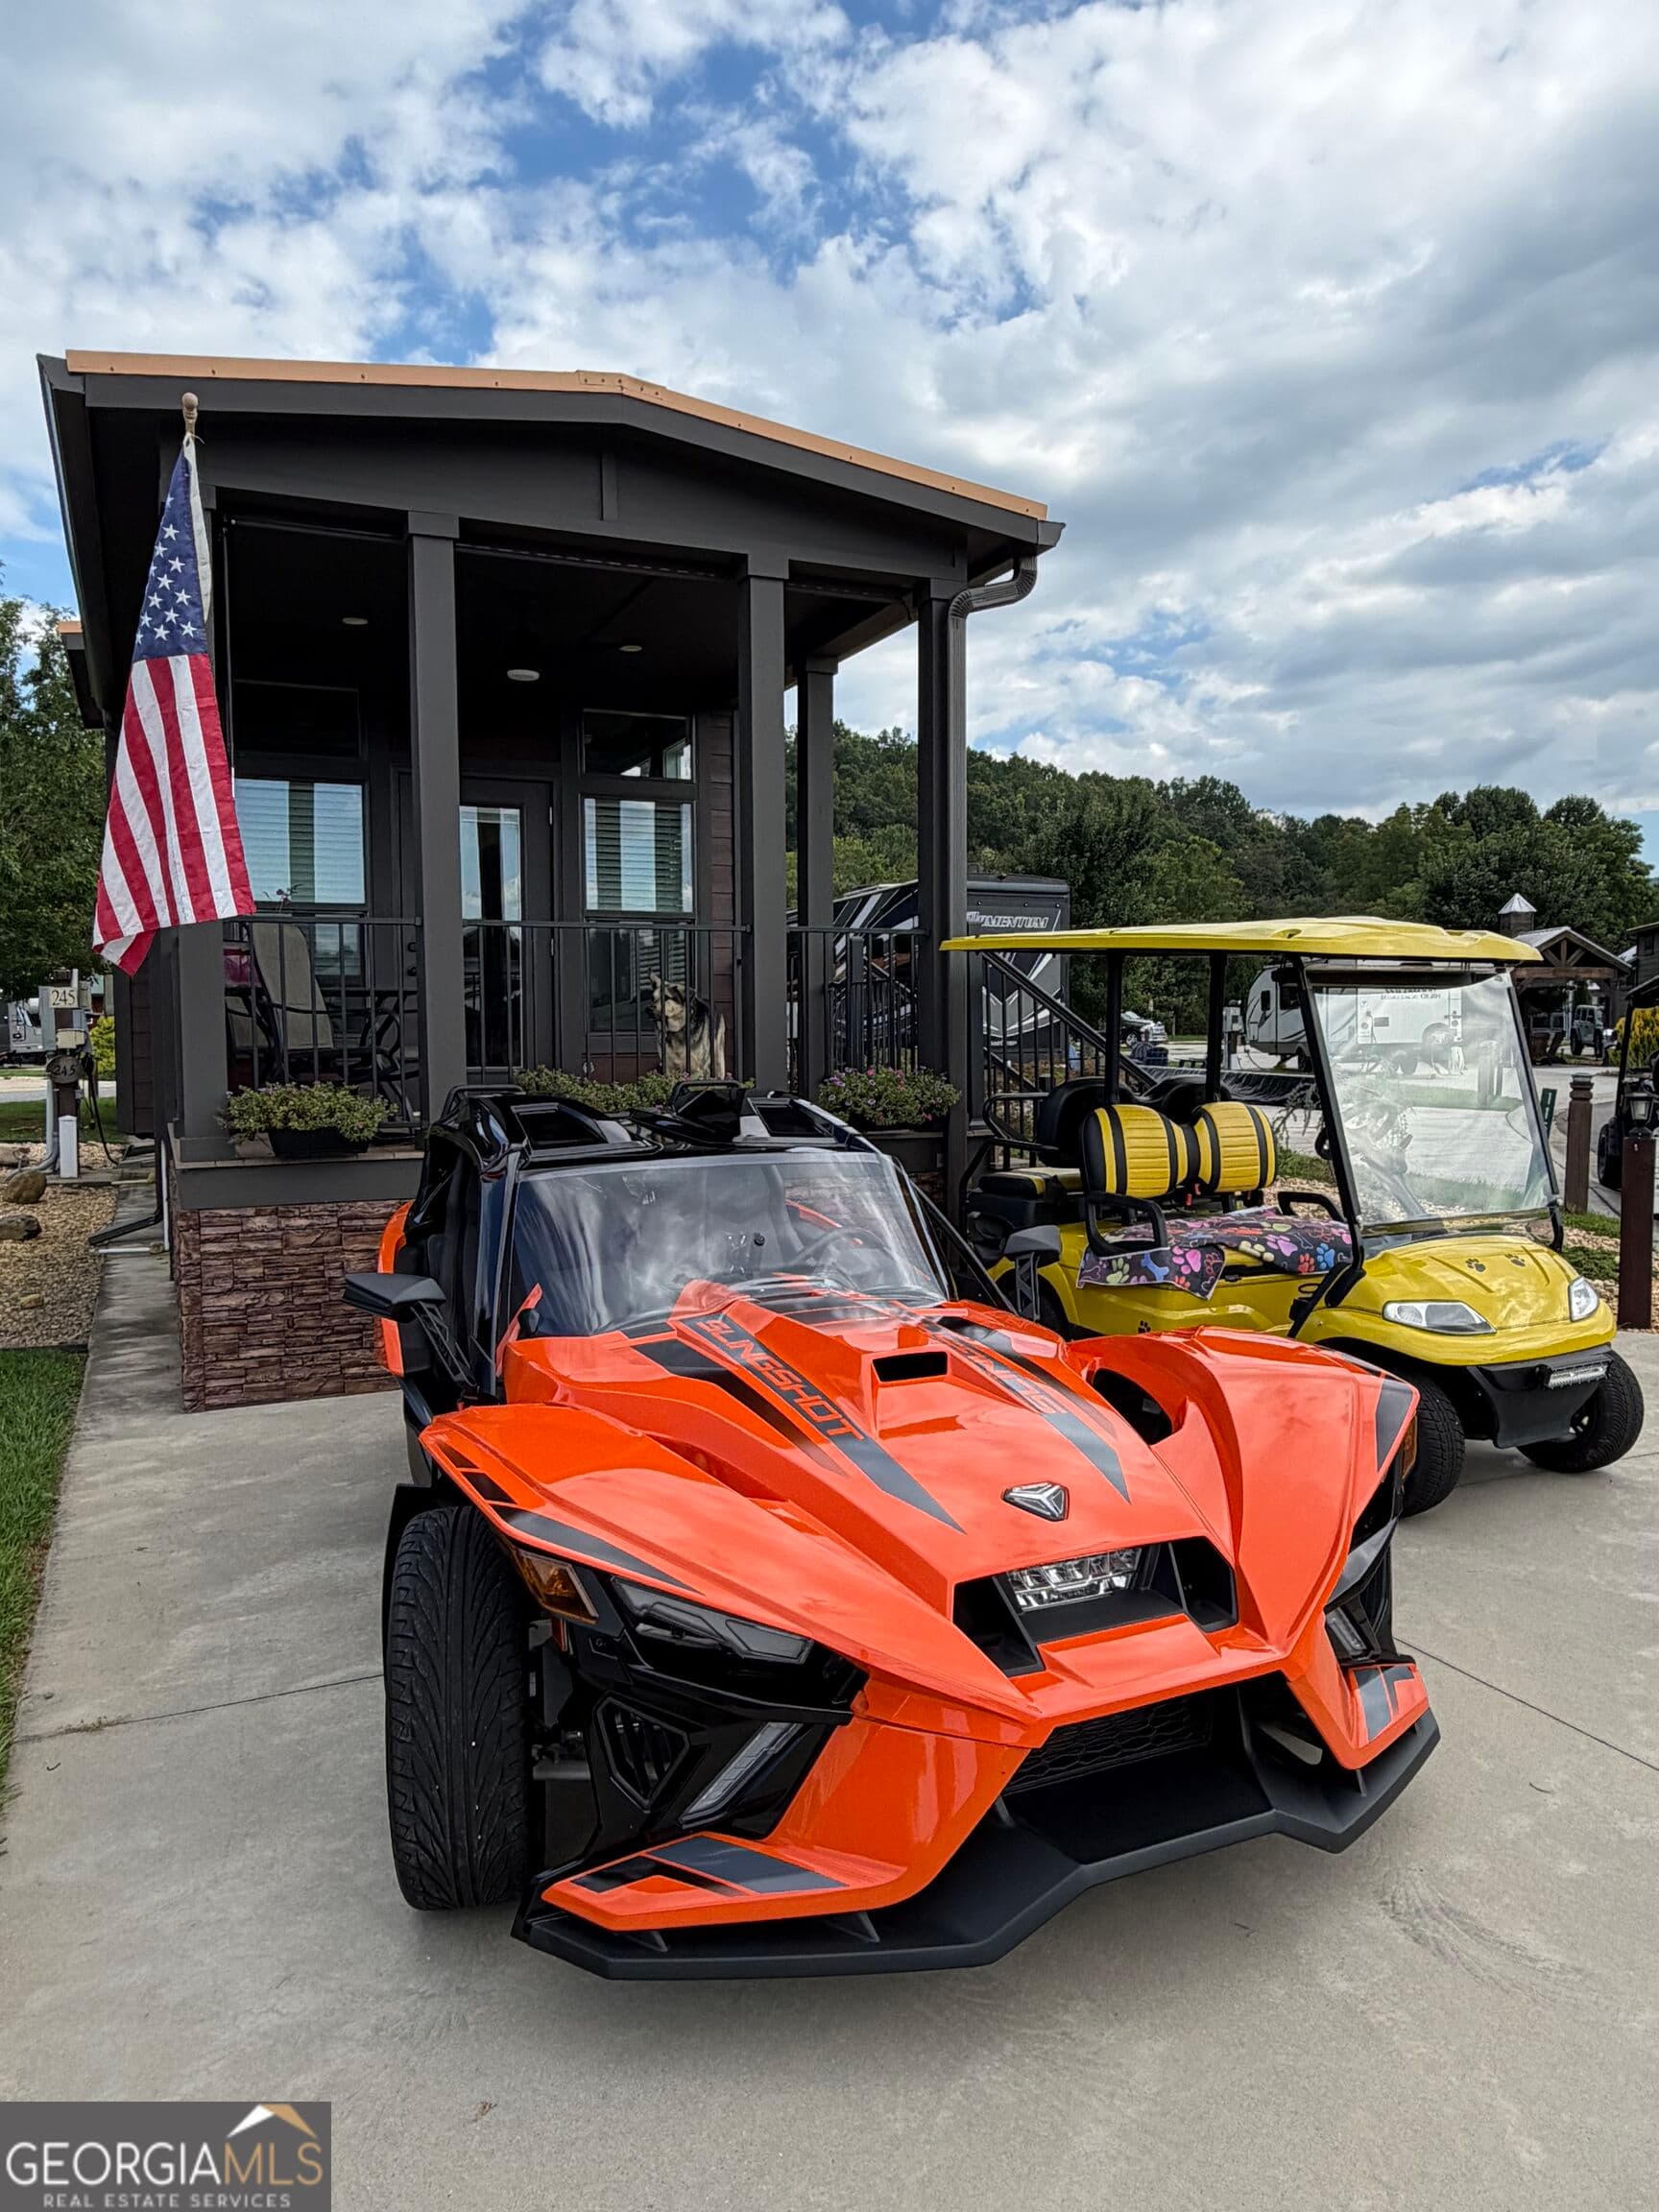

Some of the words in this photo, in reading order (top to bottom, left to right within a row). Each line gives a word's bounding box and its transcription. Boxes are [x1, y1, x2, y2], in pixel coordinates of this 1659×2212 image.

[52, 990, 76, 1006] 245
[51, 1064, 76, 1076] 245
[696, 1319, 865, 1441] SLINGSHOT
